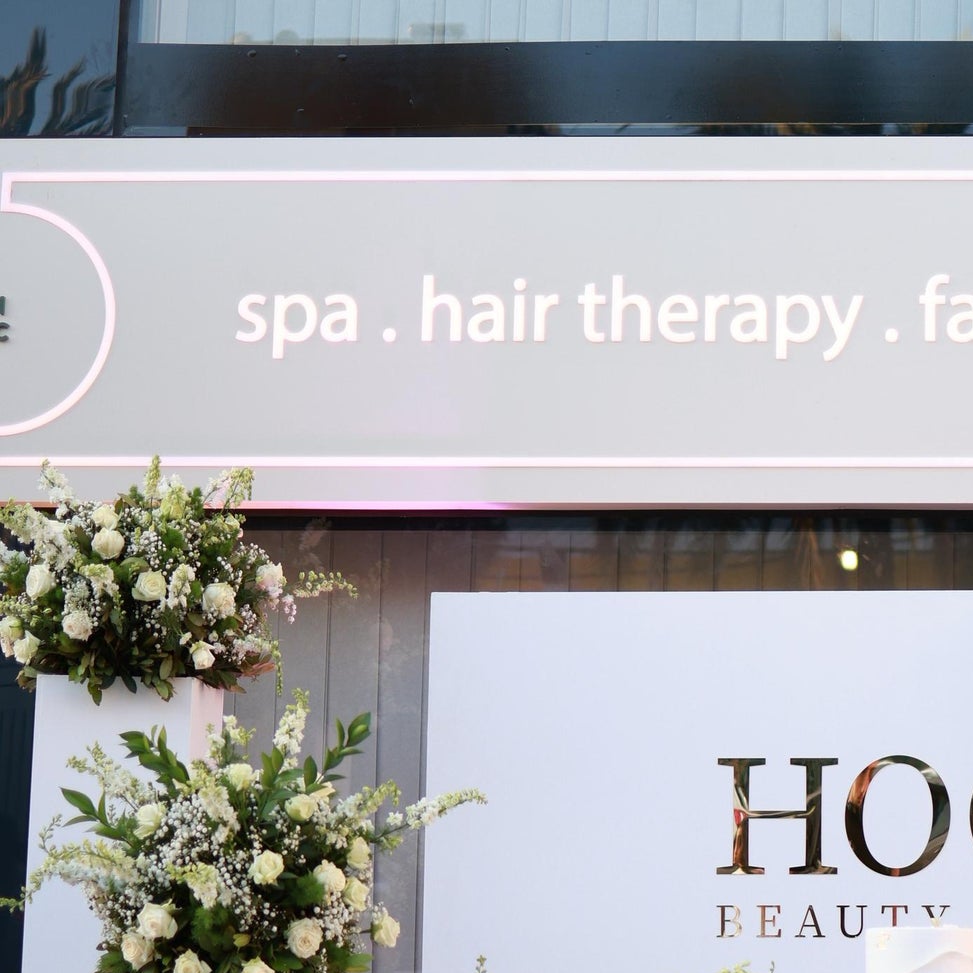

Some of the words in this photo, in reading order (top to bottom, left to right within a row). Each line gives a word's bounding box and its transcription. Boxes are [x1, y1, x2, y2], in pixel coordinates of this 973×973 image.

[235, 293, 359, 360] spa
[420, 273, 560, 343] hair
[576, 274, 864, 362] therapy
[715, 903, 952, 940] BEAUTY
